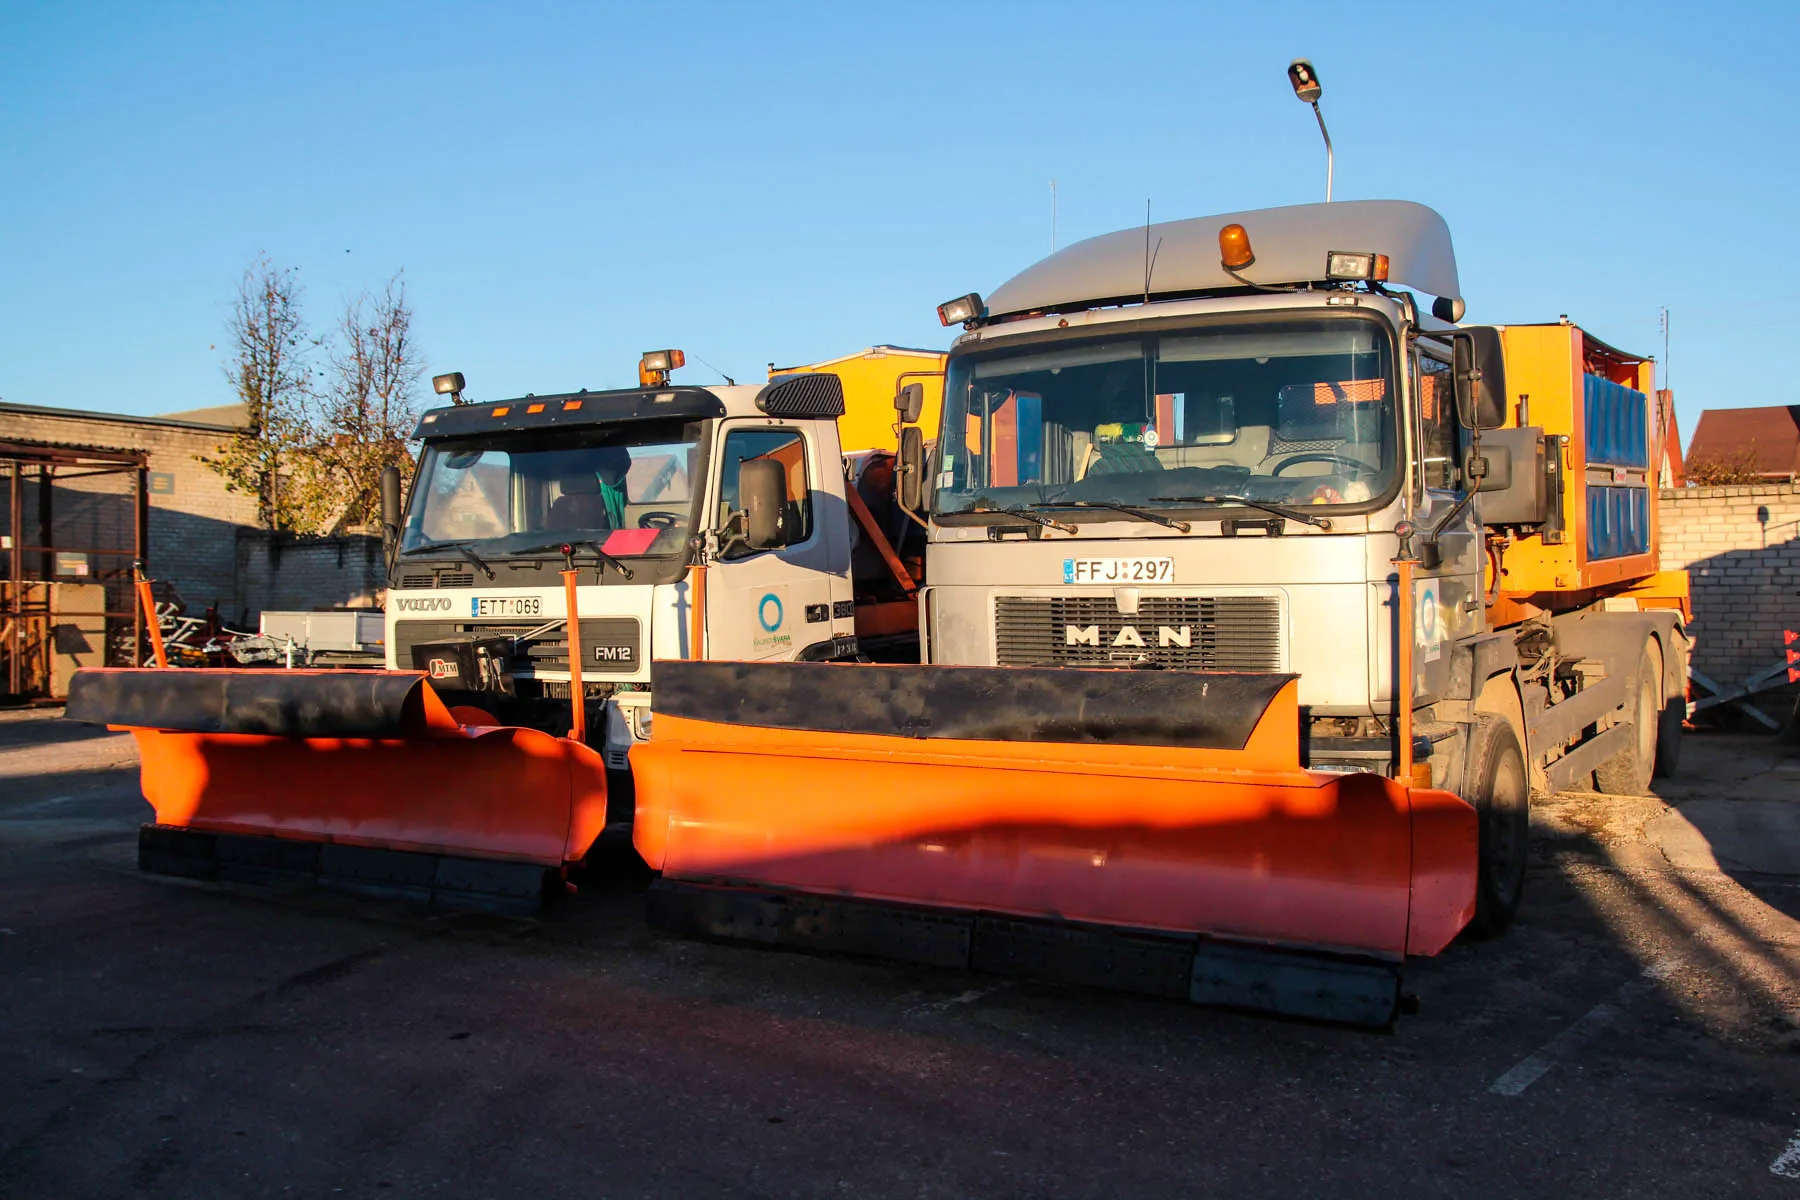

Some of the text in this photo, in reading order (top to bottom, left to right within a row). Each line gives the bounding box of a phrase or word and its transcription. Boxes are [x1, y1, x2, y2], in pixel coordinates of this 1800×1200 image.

[1076, 561, 1171, 580] FFJ 297
[396, 598, 452, 611] VOLVO
[480, 599, 539, 615] ETT 069
[834, 603, 854, 616] 380
[1066, 625, 1191, 647] MAN
[595, 647, 631, 660] FM12
[438, 664, 457, 673] MTM
